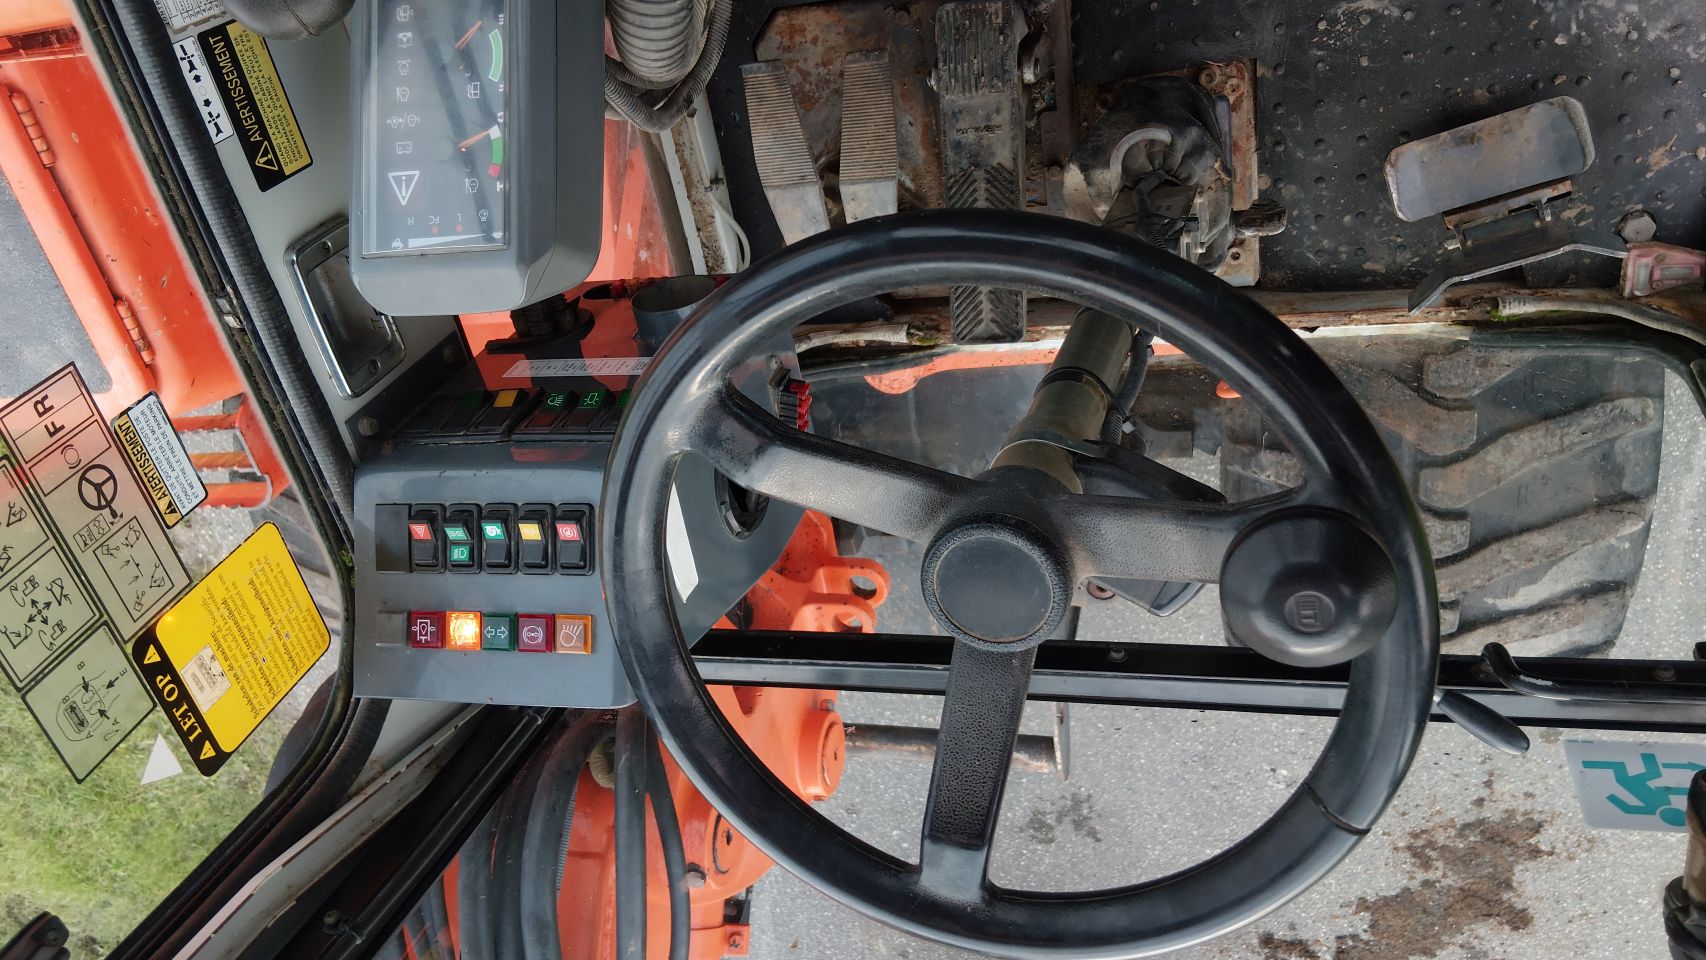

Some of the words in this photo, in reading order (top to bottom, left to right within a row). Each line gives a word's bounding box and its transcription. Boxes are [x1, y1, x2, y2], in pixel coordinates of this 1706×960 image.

[234, 36, 240, 46] DE
[242, 29, 251, 43] EST
[246, 55, 257, 74] PEUT
[261, 74, 267, 84] LA
[209, 36, 262, 141] AVERTISSEMENT
[251, 82, 260, 95] EST
[255, 76, 268, 102] CABINE
[265, 86, 278, 111] QUAND
[258, 98, 273, 130] MACHINE
[278, 104, 285, 113] LA
[282, 113, 290, 127] SUR
[271, 131, 278, 141] LA
[276, 142, 288, 167] QUAND
[280, 141, 294, 164] GODET
[34, 393, 54, 418] R
[133, 415, 142, 426] DE
[140, 409, 156, 436] MOTEUR
[44, 421, 66, 438] F
[138, 425, 152, 447] POSTE
[160, 430, 168, 440] DE
[153, 435, 162, 445] LE
[150, 447, 158, 456] LE
[166, 439, 177, 458] FREIN
[118, 421, 168, 500] AVERTISSEMENT
[158, 444, 176, 472] ARRETER
[175, 458, 182, 467] LE
[154, 455, 172, 482] QUITTER
[168, 481, 176, 491] DE
[180, 466, 194, 491] METTRE
[174, 492, 186, 509] AVANT
[216, 624, 223, 633] de
[273, 626, 283, 642] voor
[77, 661, 86, 670] B
[249, 650, 259, 666] voor
[282, 642, 300, 676] Schakelen
[120, 667, 128, 677] E
[227, 662, 234, 672] de
[233, 672, 241, 685] van
[237, 664, 254, 691] machine
[258, 666, 277, 700] Schakelen
[156, 674, 178, 701] OP
[252, 691, 259, 700] de
[62, 695, 70, 704] B
[240, 684, 260, 719] Schakelen
[112, 716, 120, 726] A
[172, 702, 202, 742] LET
[86, 730, 94, 738] A
